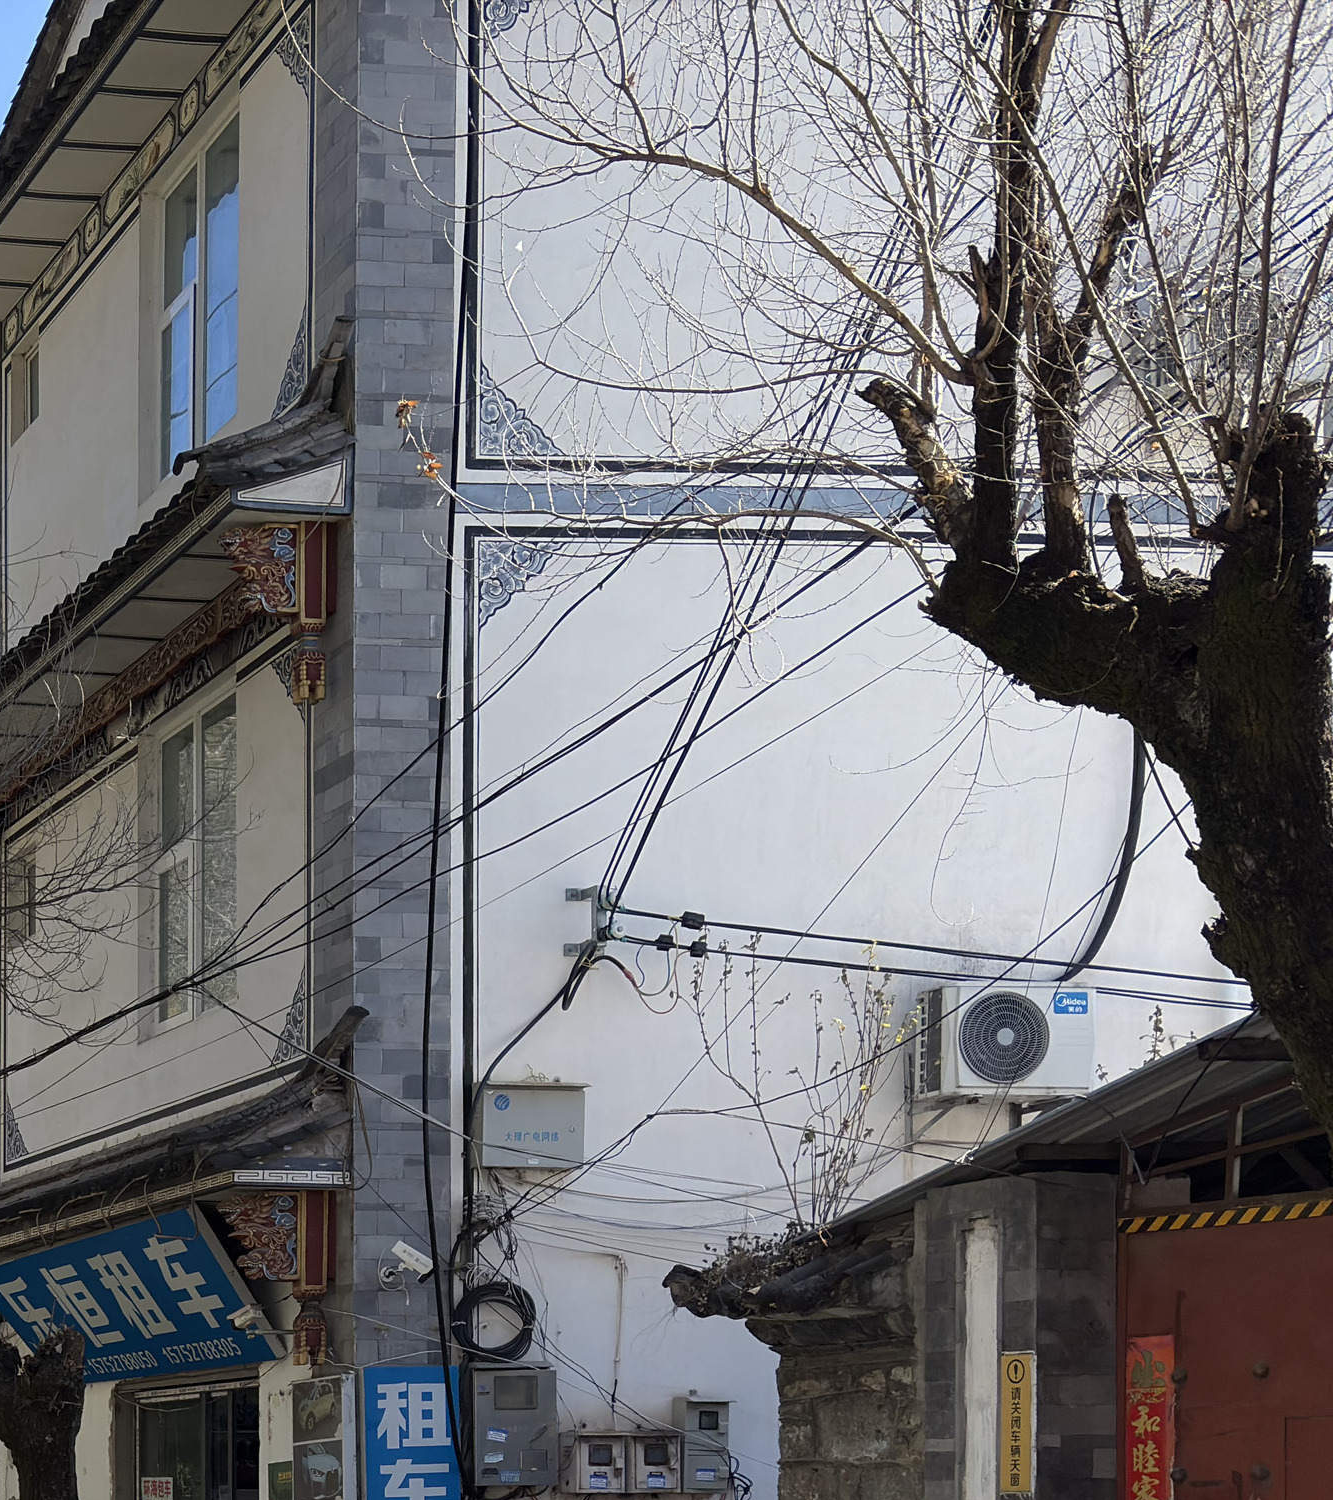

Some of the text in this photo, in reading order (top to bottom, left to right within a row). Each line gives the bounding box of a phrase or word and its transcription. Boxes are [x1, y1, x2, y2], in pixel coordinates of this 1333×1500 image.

[1055, 993, 1087, 1007] Midea
[505, 1131, 560, 1142] 大理广电网络
[162, 1336, 243, 1365] 15752788305
[1010, 1387, 1022, 1487] 请关闭车辆天窗
